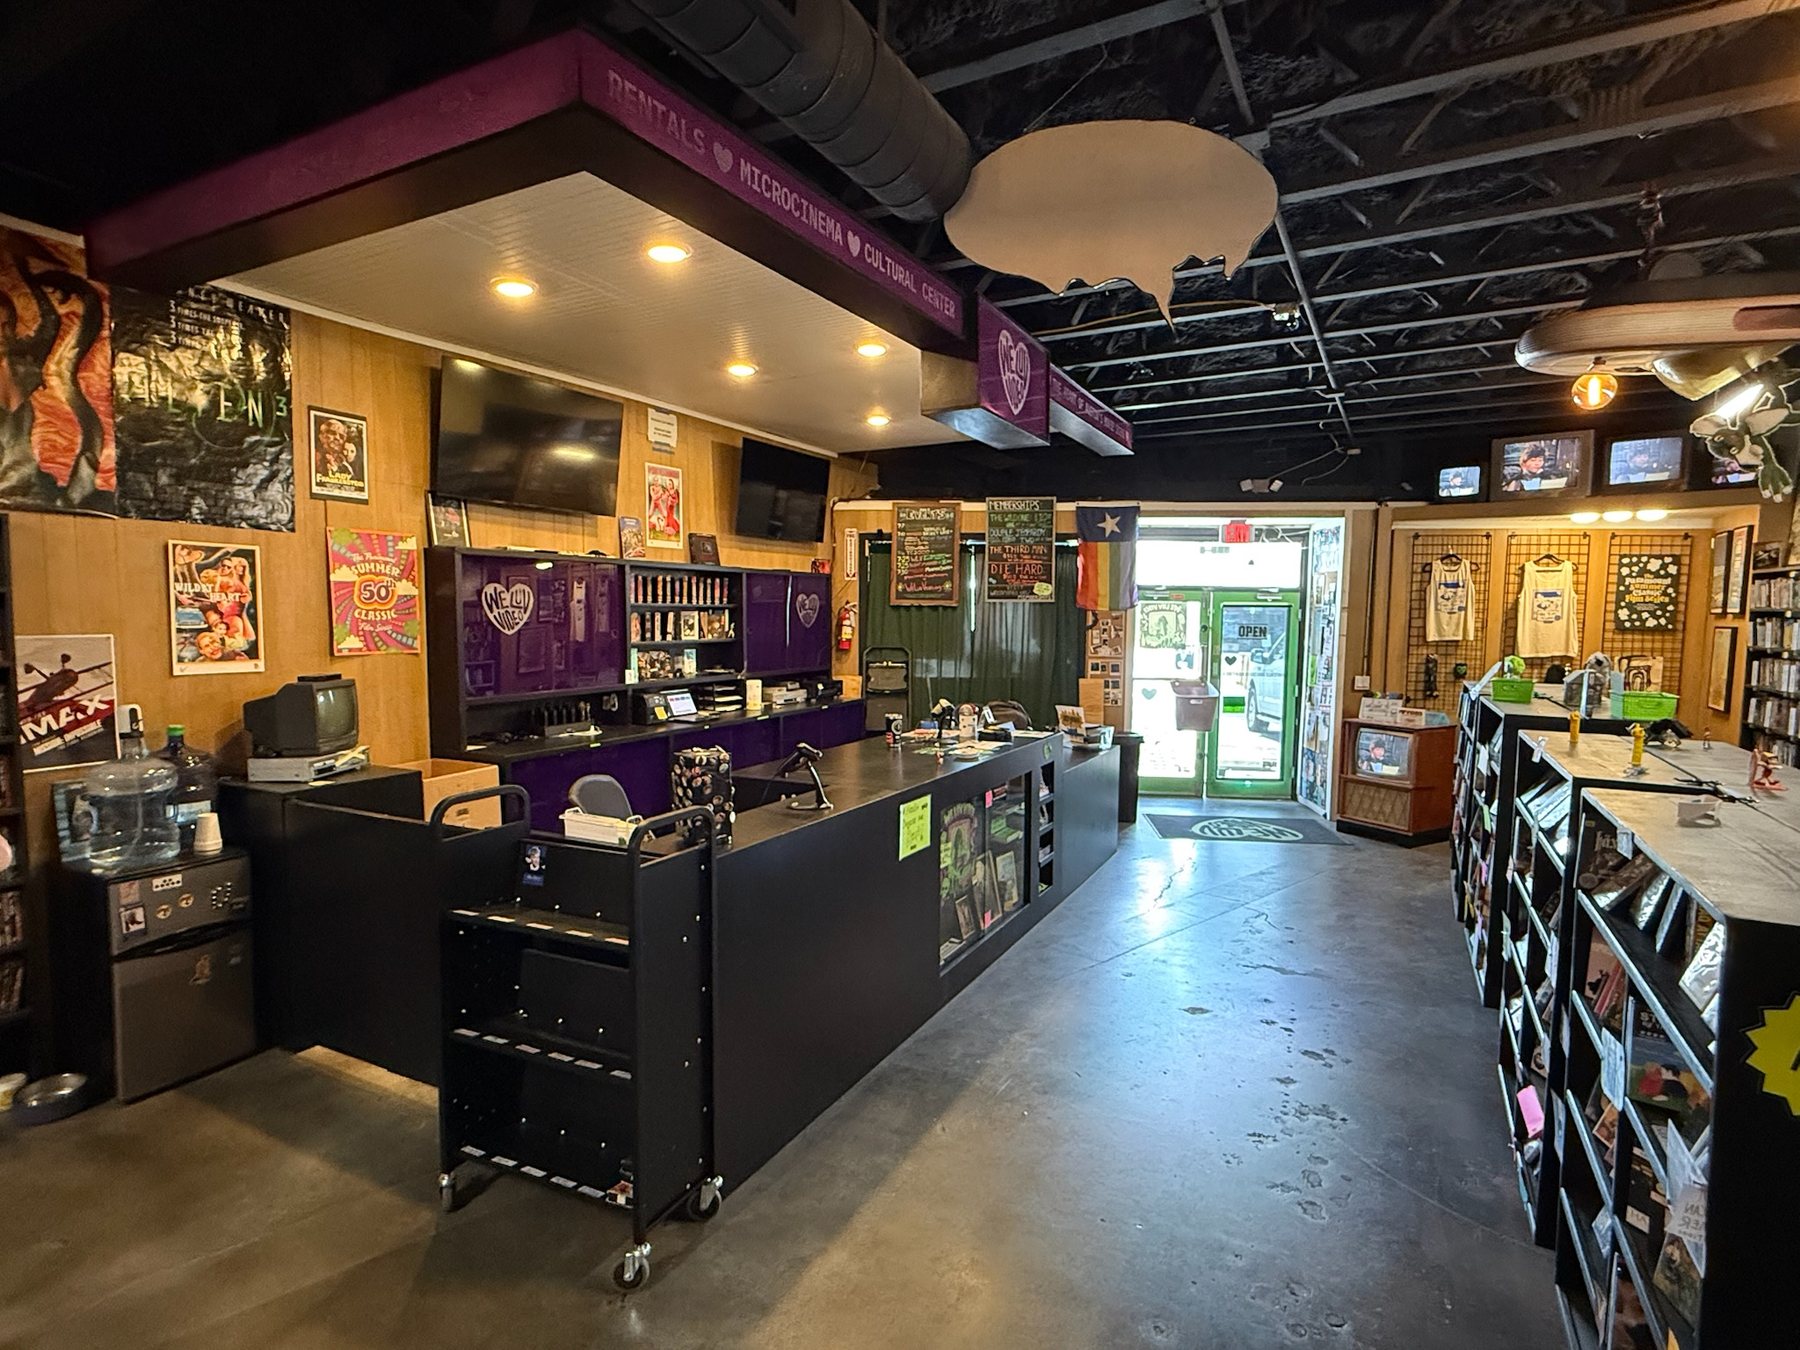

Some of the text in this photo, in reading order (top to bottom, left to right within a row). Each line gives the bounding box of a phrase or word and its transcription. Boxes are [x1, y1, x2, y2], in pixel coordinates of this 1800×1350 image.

[607, 68, 956, 320] RENTALS MICROCINEMA CULTURAL CENTER
[328, 470, 352, 480] LADY
[989, 500, 1040, 511] MEMBERSHIPS
[989, 545, 1002, 554] THE
[1004, 544, 1030, 554] THIRD
[351, 562, 400, 577] SUMMER
[991, 563, 1043, 575] DIE HARD
[174, 582, 201, 593] WILD
[209, 592, 241, 602] HEART
[485, 587, 530, 614] WE LUV
[354, 609, 397, 621] CLASSIC
[493, 610, 524, 631] VIDEO
[1238, 626, 1267, 637] OPEN
